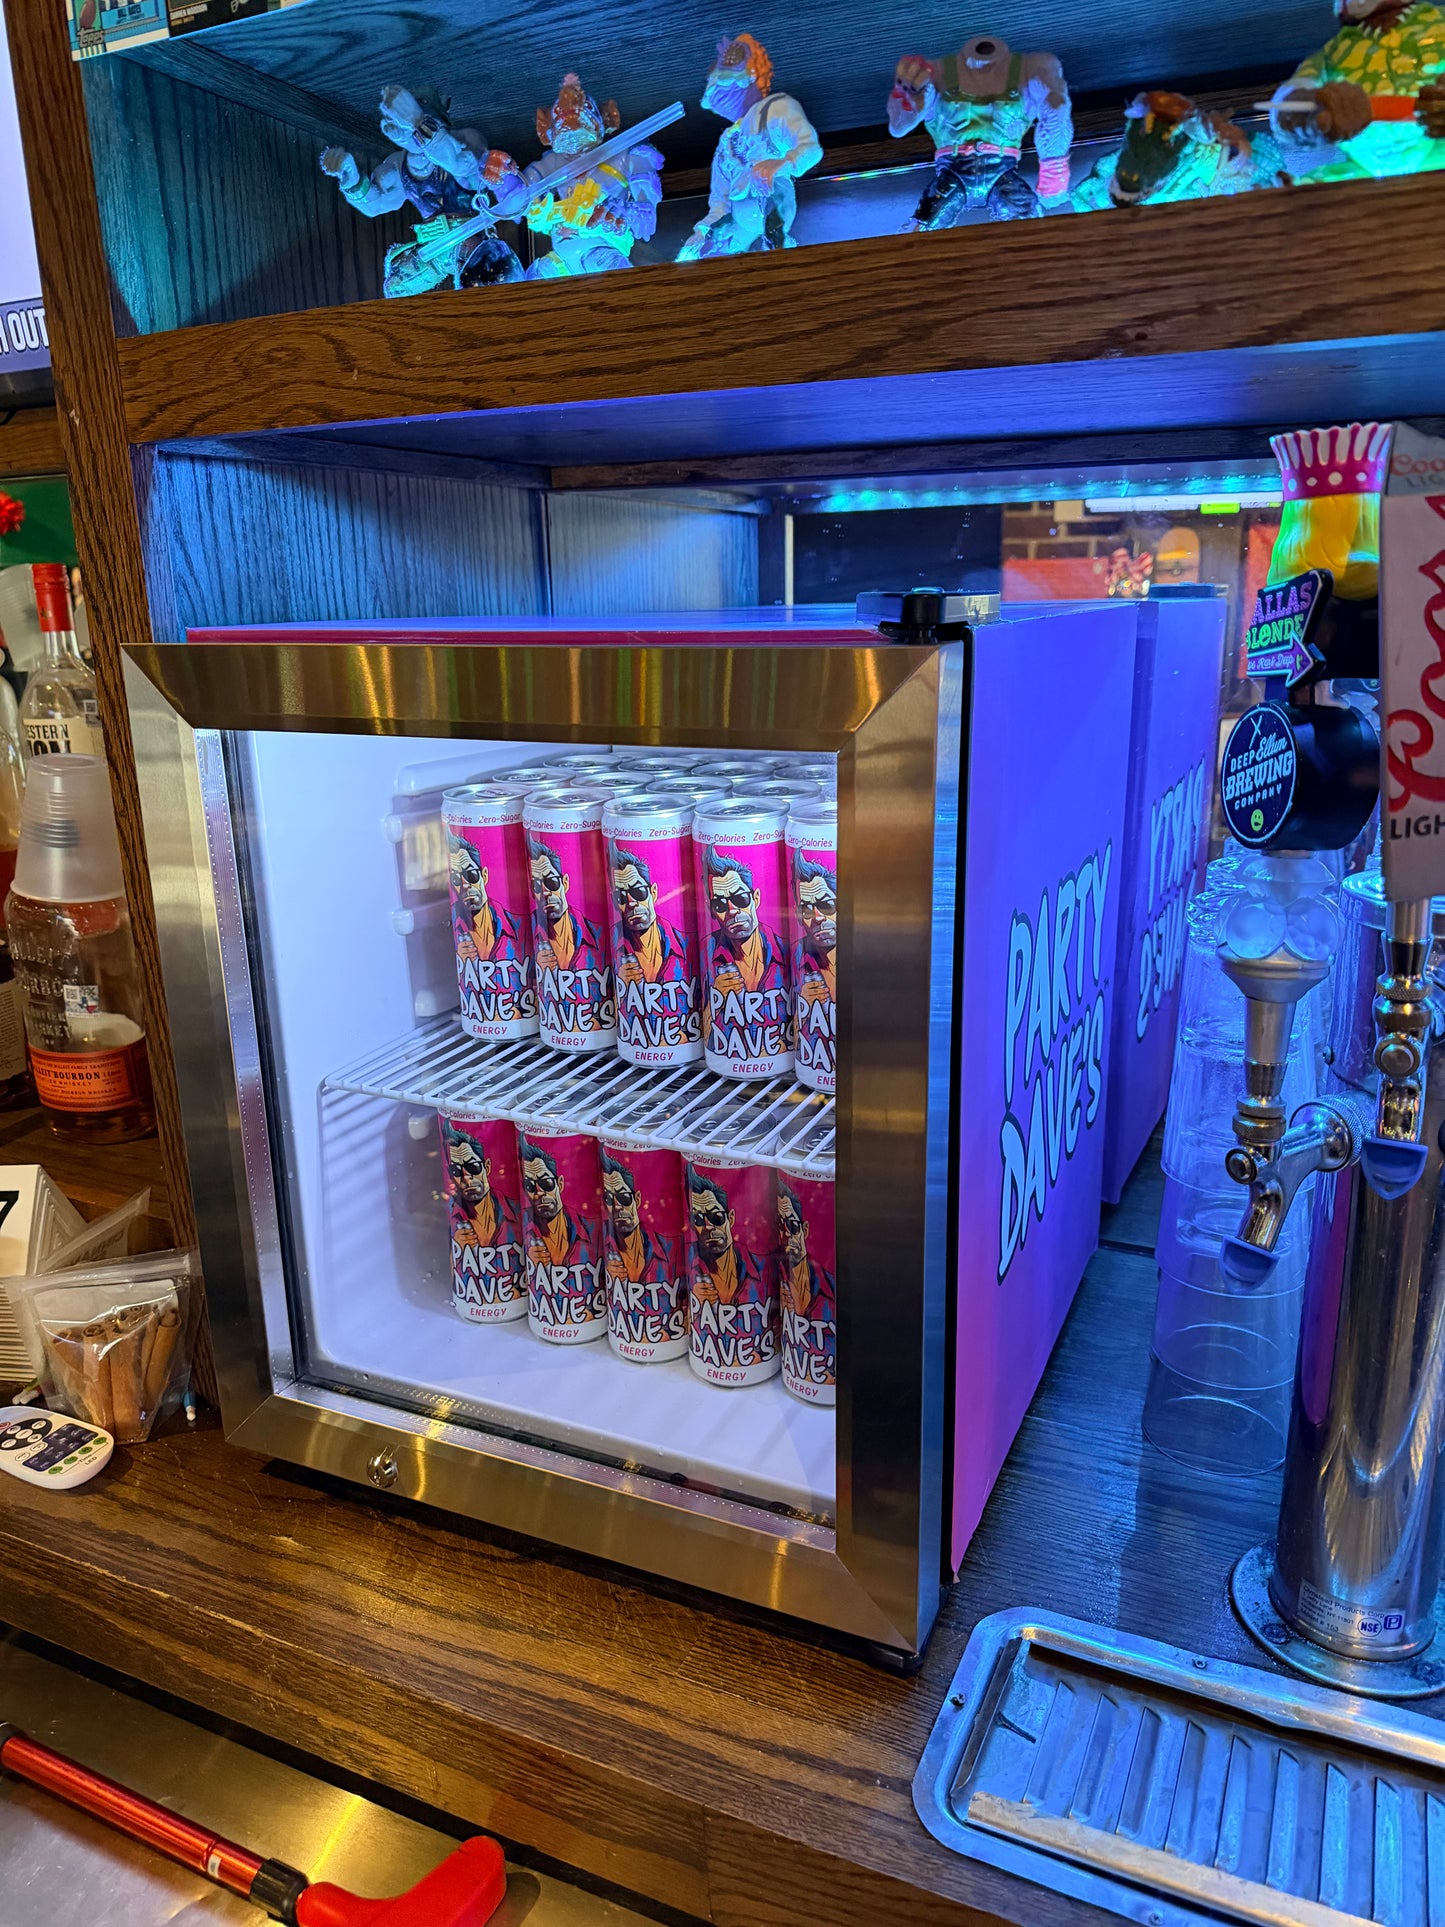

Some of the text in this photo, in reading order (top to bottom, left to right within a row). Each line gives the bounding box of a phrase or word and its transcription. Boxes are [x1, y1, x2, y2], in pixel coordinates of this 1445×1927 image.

[7, 306, 50, 353] OUT
[1390, 454, 1445, 477] Coo
[1251, 581, 1313, 626] ALLAS
[26, 724, 70, 740] ESTERN
[1230, 732, 1288, 773] DEEP Ellum
[1225, 750, 1293, 801] BREWING
[1234, 783, 1282, 811] COMPANY
[560, 819, 601, 830] Zero-Suga
[698, 830, 786, 843] Zero-Calories Zero-Sug
[1390, 814, 1445, 840] LIGH
[456, 953, 531, 993] PARTY
[1006, 837, 1112, 1104] PARTY
[459, 985, 537, 1024] DAVE'S
[616, 974, 697, 1017] PARTY
[710, 985, 795, 1028] PARTY
[538, 994, 617, 1035] DAVE'S
[472, 1025, 508, 1035] ENERGY
[551, 1035, 587, 1047] ENERGY
[618, 1010, 701, 1050] DAVE'S
[635, 1051, 674, 1062] ENERGY
[732, 1062, 774, 1073] ENERGY
[53, 1071, 100, 1081] BOURBON
[816, 1075, 836, 1087] ENE
[997, 990, 1106, 1287] DAVE'S
[470, 1307, 507, 1317] ENERGY
[528, 1286, 608, 1327] DAVE'S
[690, 1292, 772, 1337] PARTY
[542, 1327, 579, 1338] ENERGY
[781, 1307, 836, 1351] ART
[619, 1343, 655, 1358] ENERGY
[691, 1325, 775, 1369] DAVE'S
[707, 1368, 747, 1381] ENERGY
[781, 1341, 836, 1384] AVE'
[786, 1375, 819, 1398] ENERGY
[1334, 1600, 1366, 1616] Products
[1367, 1610, 1385, 1619] Corp
